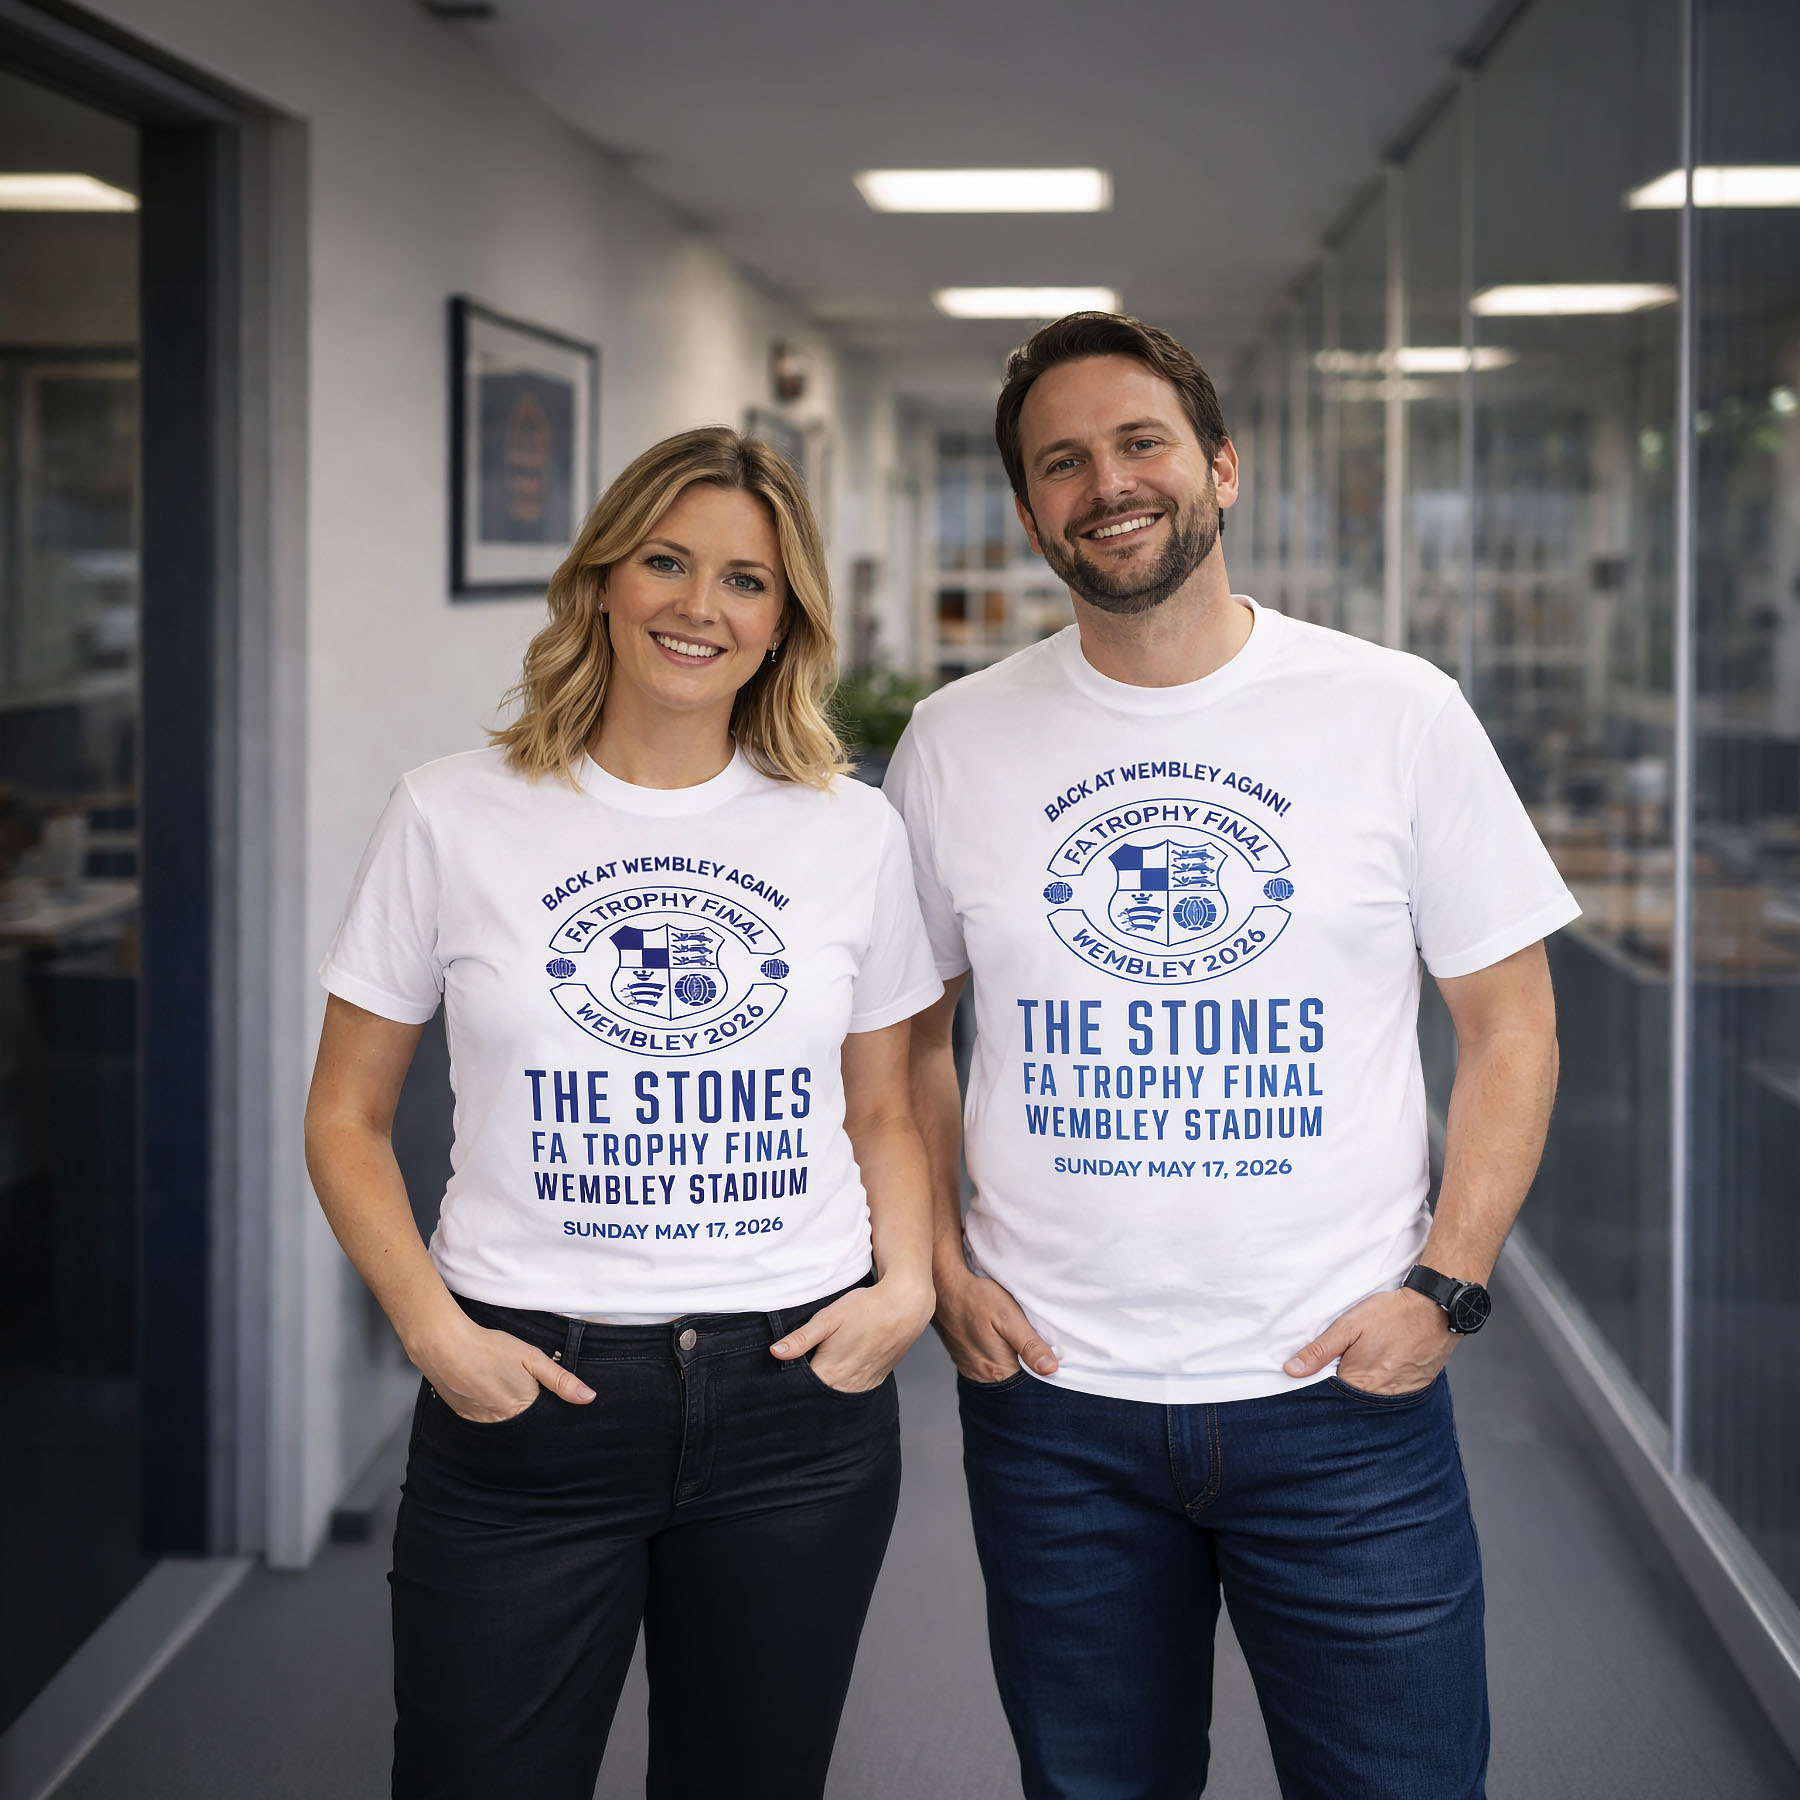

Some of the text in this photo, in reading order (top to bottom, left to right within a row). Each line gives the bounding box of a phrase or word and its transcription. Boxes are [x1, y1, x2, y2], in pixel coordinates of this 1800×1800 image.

[1044, 761, 1291, 823] BACK AT WEMBLEY AGAIN!
[1063, 805, 1269, 865] FA TROPHY FINAL
[541, 856, 790, 911] BACK AT WEMBLEY AGAIN!
[564, 892, 764, 945] FA TROPHY FINAL
[1072, 928, 1266, 978] WEMBLEY 2026
[576, 1002, 764, 1051] WEMBLEY 2026
[1016, 997, 1324, 1056] THE STONES
[524, 1066, 812, 1125] THE STONES
[1023, 1061, 1324, 1100] FA TROPHY FINAL
[1025, 1103, 1323, 1141] WEMBLEY STADIUM
[532, 1127, 809, 1167] FA TROPHY FINAL
[1054, 1156, 1293, 1180] SUNDAY MAY 17, 2026
[534, 1167, 808, 1206] WEMBLEY STADIUM
[563, 1216, 784, 1241] SUNDAY MAY 17, 2026
